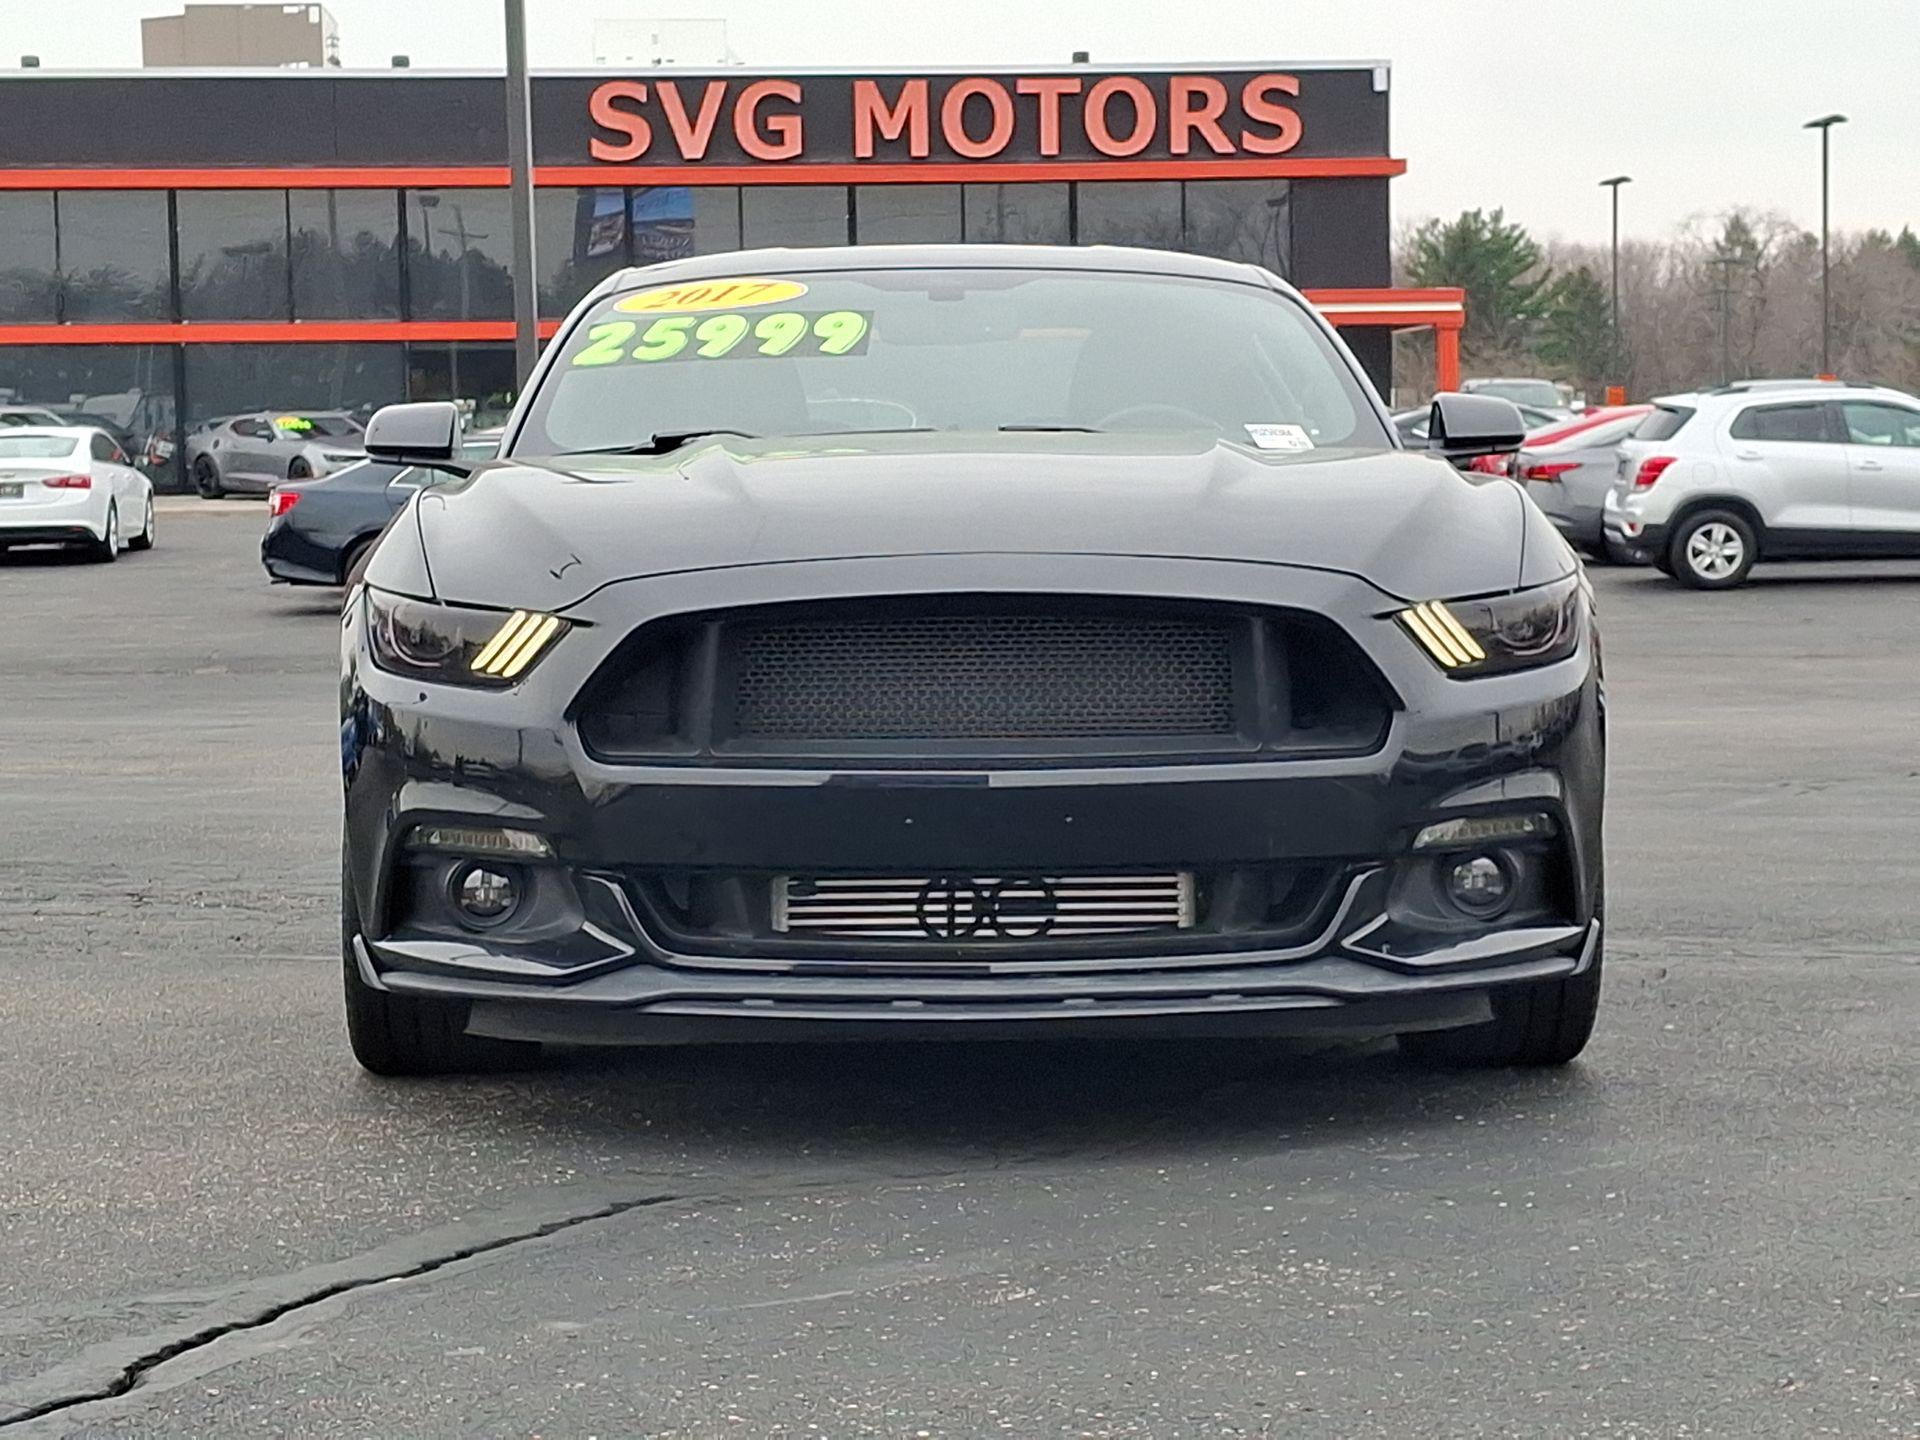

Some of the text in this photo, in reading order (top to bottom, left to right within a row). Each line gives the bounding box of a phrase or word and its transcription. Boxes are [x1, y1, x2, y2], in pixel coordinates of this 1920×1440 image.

[588, 75, 1304, 162] SVG MOTORS
[646, 284, 776, 309] 2017
[571, 311, 868, 366] 25999
